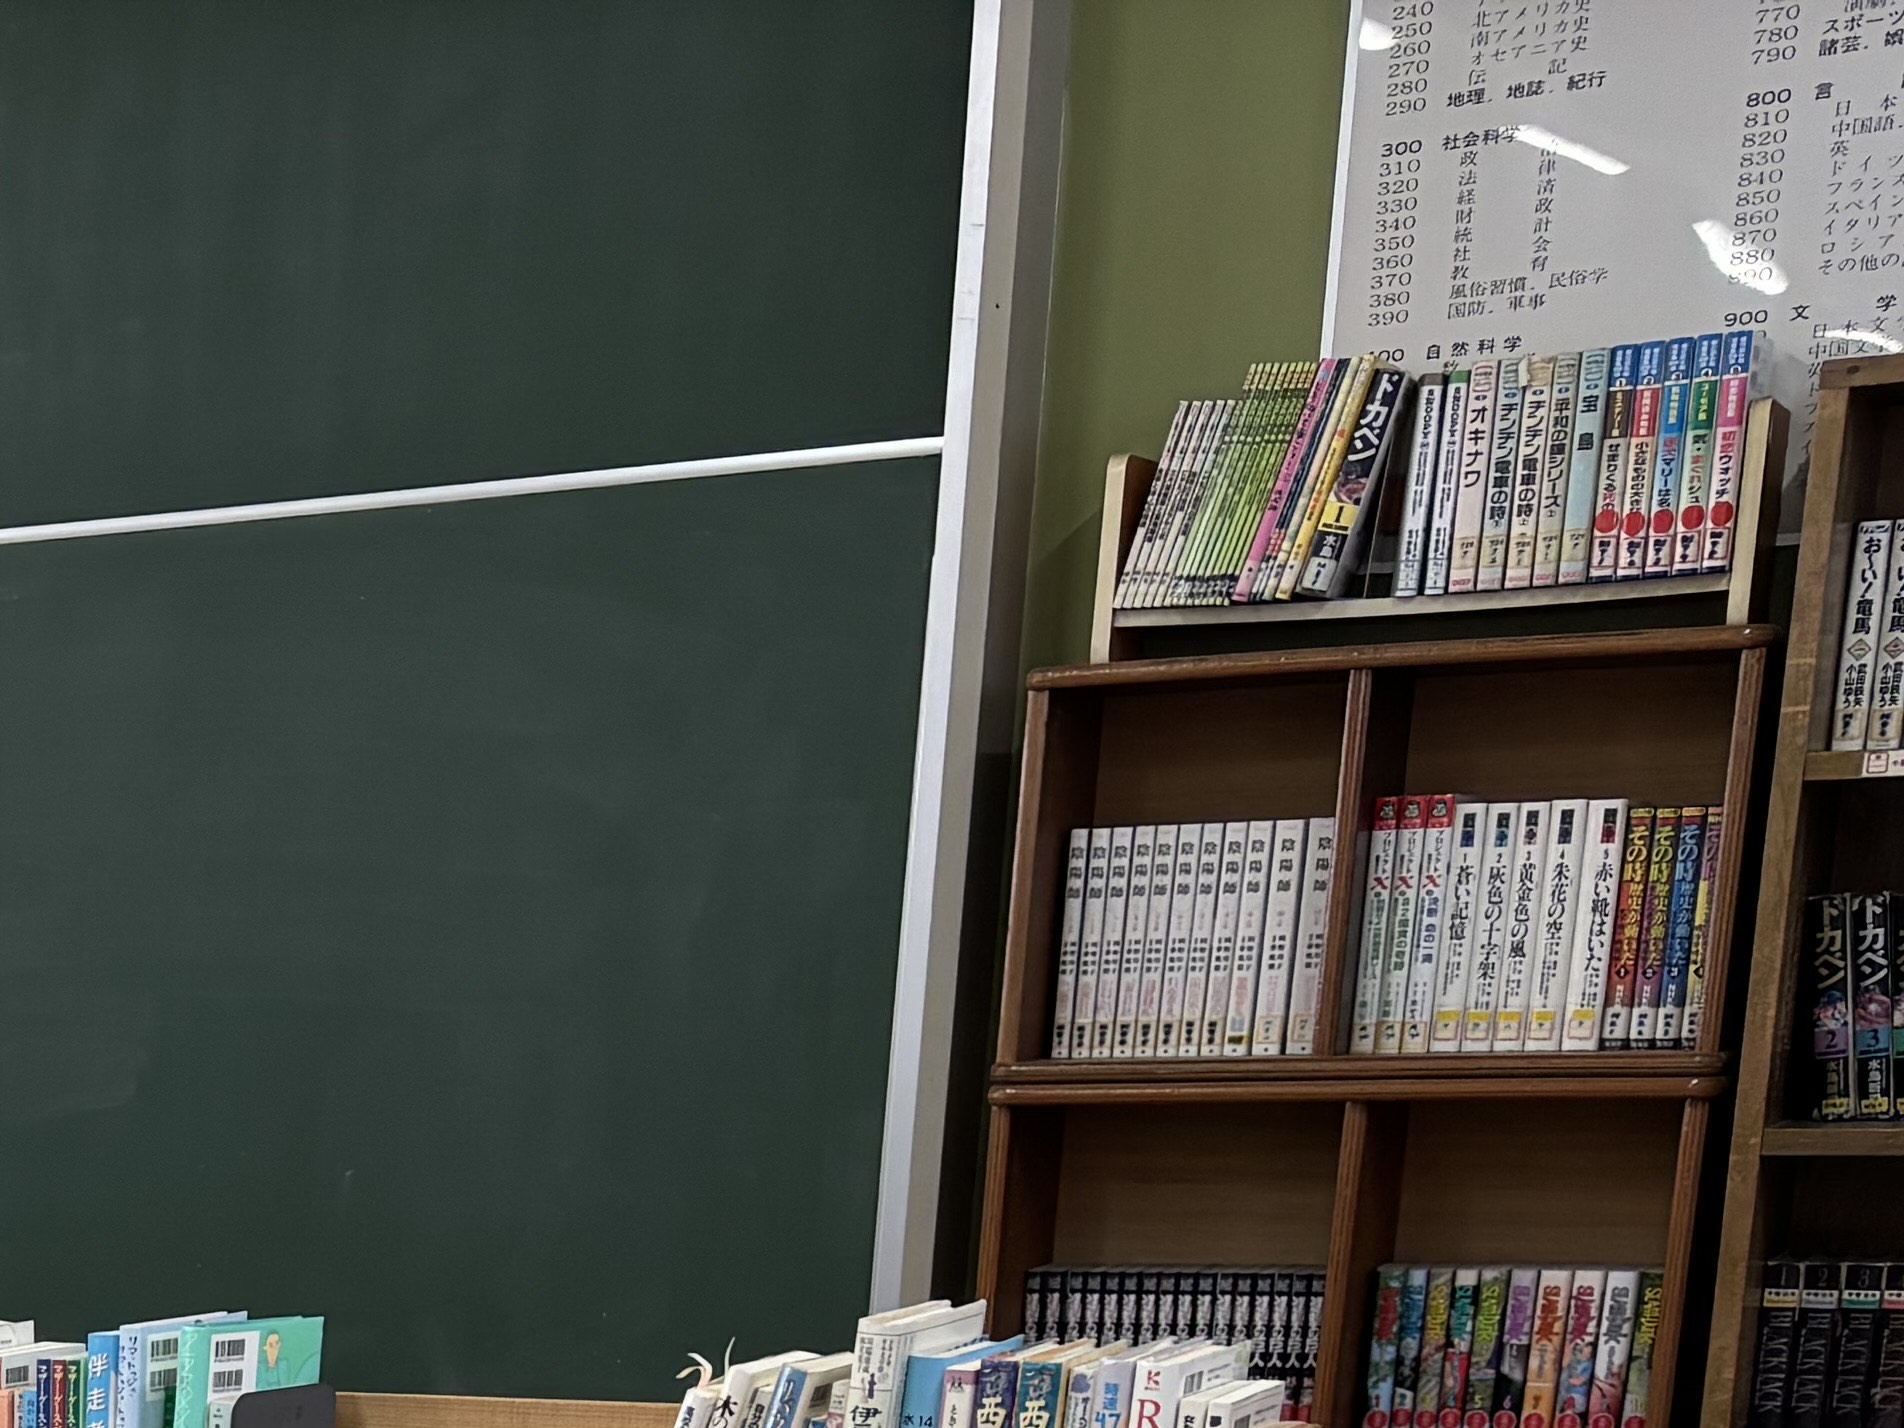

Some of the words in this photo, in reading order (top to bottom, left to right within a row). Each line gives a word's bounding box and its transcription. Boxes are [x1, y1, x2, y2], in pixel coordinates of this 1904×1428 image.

[1753, 25, 1799, 45] 780
[1751, 46, 1797, 65] 790
[1387, 60, 1430, 78] 270
[1386, 78, 1428, 97] 280
[1384, 97, 1427, 116] 290
[1746, 89, 1792, 108] 800
[1744, 109, 1790, 128] 810
[1381, 140, 1423, 158] 300
[1379, 159, 1421, 177] 310
[1377, 177, 1419, 196] 320
[1376, 197, 1418, 215] 330
[1373, 234, 1415, 252] 350
[1372, 253, 1414, 271] 360
[1370, 272, 1412, 289] 370
[1367, 309, 1409, 327] 390
[1724, 310, 1768, 327] 900
[1815, 896, 1848, 990] ドカベン
[1855, 896, 1890, 987] ドカベン
